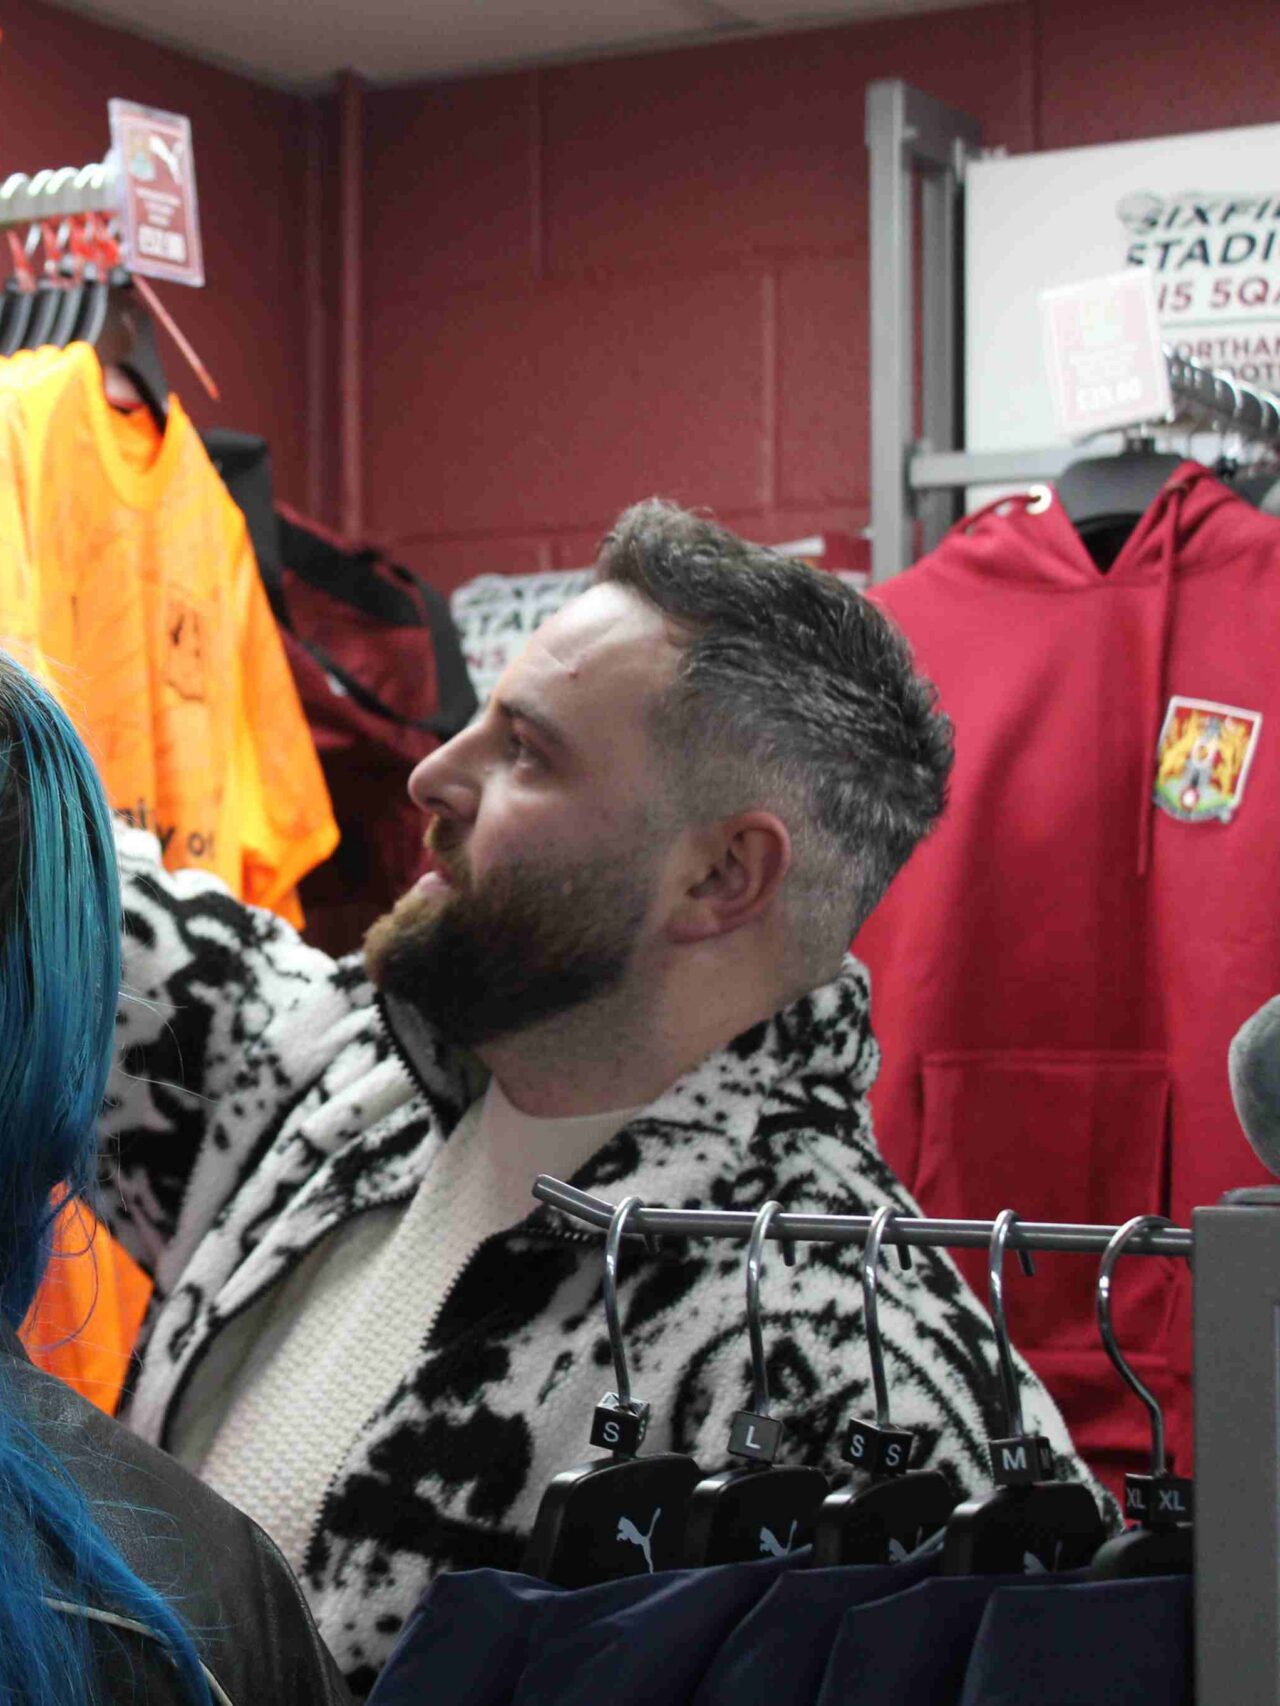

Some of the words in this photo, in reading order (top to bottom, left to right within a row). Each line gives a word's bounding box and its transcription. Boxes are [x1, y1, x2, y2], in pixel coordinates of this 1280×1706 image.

[602, 1421, 621, 1443] S
[745, 1425, 762, 1450] L
[850, 1433, 866, 1458] S
[885, 1443, 901, 1467] S
[1001, 1446, 1028, 1471] M
[1126, 1487, 1147, 1509] XL
[1158, 1490, 1186, 1511] XL
